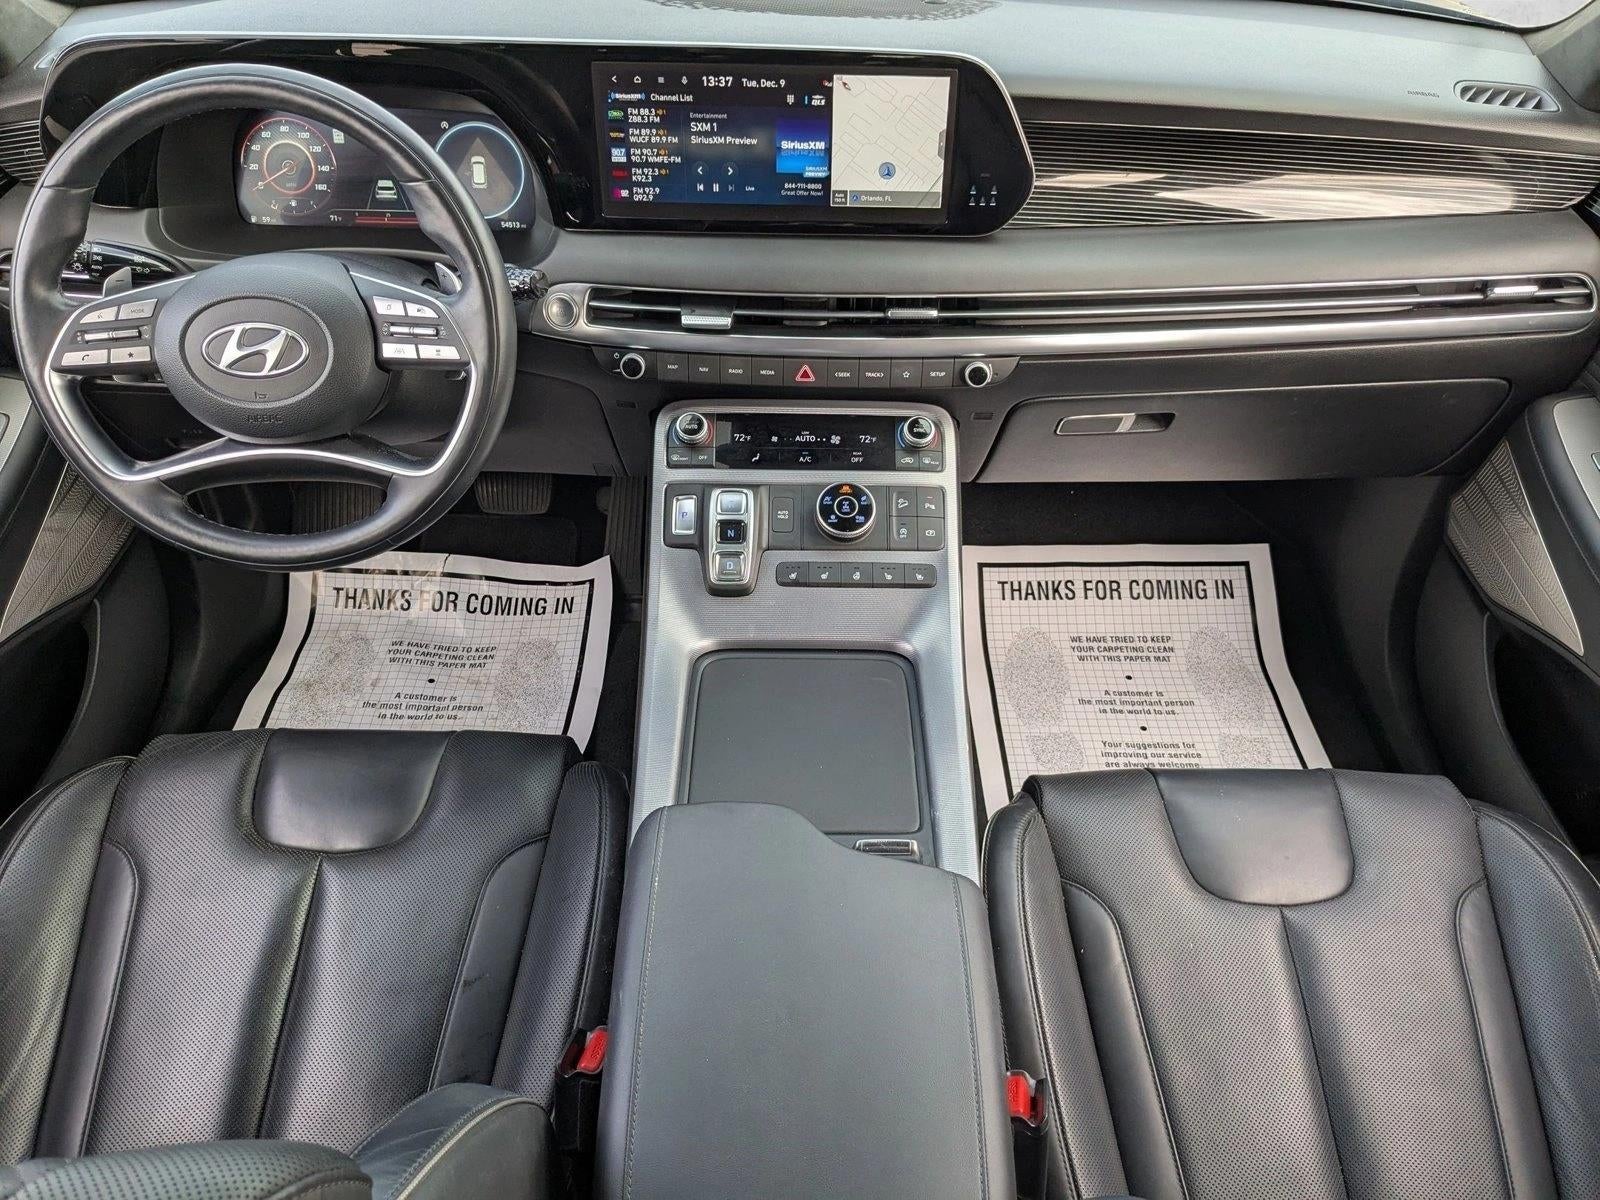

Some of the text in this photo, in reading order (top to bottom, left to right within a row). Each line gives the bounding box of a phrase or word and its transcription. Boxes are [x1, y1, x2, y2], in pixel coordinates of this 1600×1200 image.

[702, 76, 786, 88] 13:37 Tue, Dec. 9
[650, 93, 694, 102] Channel List
[640, 108, 656, 116] 88.3
[690, 112, 728, 120] Entertainment
[690, 122, 718, 132] SXM 1
[690, 136, 758, 145] SiriusXM Preview
[781, 141, 826, 150] SiriusXM
[647, 156, 682, 164] WMFE-FM
[861, 195, 884, 203] Orlando,
[681, 511, 688, 519] P
[727, 529, 735, 538] N
[726, 561, 734, 570] D
[997, 578, 1235, 601] THANKS FOR COMING IN
[332, 586, 575, 616] THANKS FOR COMING IN
[1070, 635, 1084, 643] WE
[1086, 635, 1108, 643] HAVE
[1110, 635, 1134, 643] TRIED
[1151, 635, 1172, 643] KEEP
[406, 641, 431, 650] HAVE
[433, 644, 459, 653] TRIED
[1071, 645, 1174, 653] YOUR CARPETING CLEAN
[387, 648, 412, 656] YOUR
[414, 650, 465, 661] CARPETING
[1124, 655, 1151, 663] PAPER
[1154, 655, 1172, 663] MAT
[414, 658, 436, 667] THIS
[437, 661, 466, 669] PAPER
[403, 693, 448, 702] customer
[1104, 689, 1111, 697] A
[362, 701, 484, 713] the most important person
[1078, 698, 1092, 706] the
[1119, 699, 1162, 707] important
[1110, 707, 1125, 715] the
[390, 712, 405, 720] the
[1101, 740, 1196, 750] Your suggestions for
[1101, 751, 1148, 759] improving
[1168, 751, 1202, 759] service
[1123, 761, 1156, 769] always
